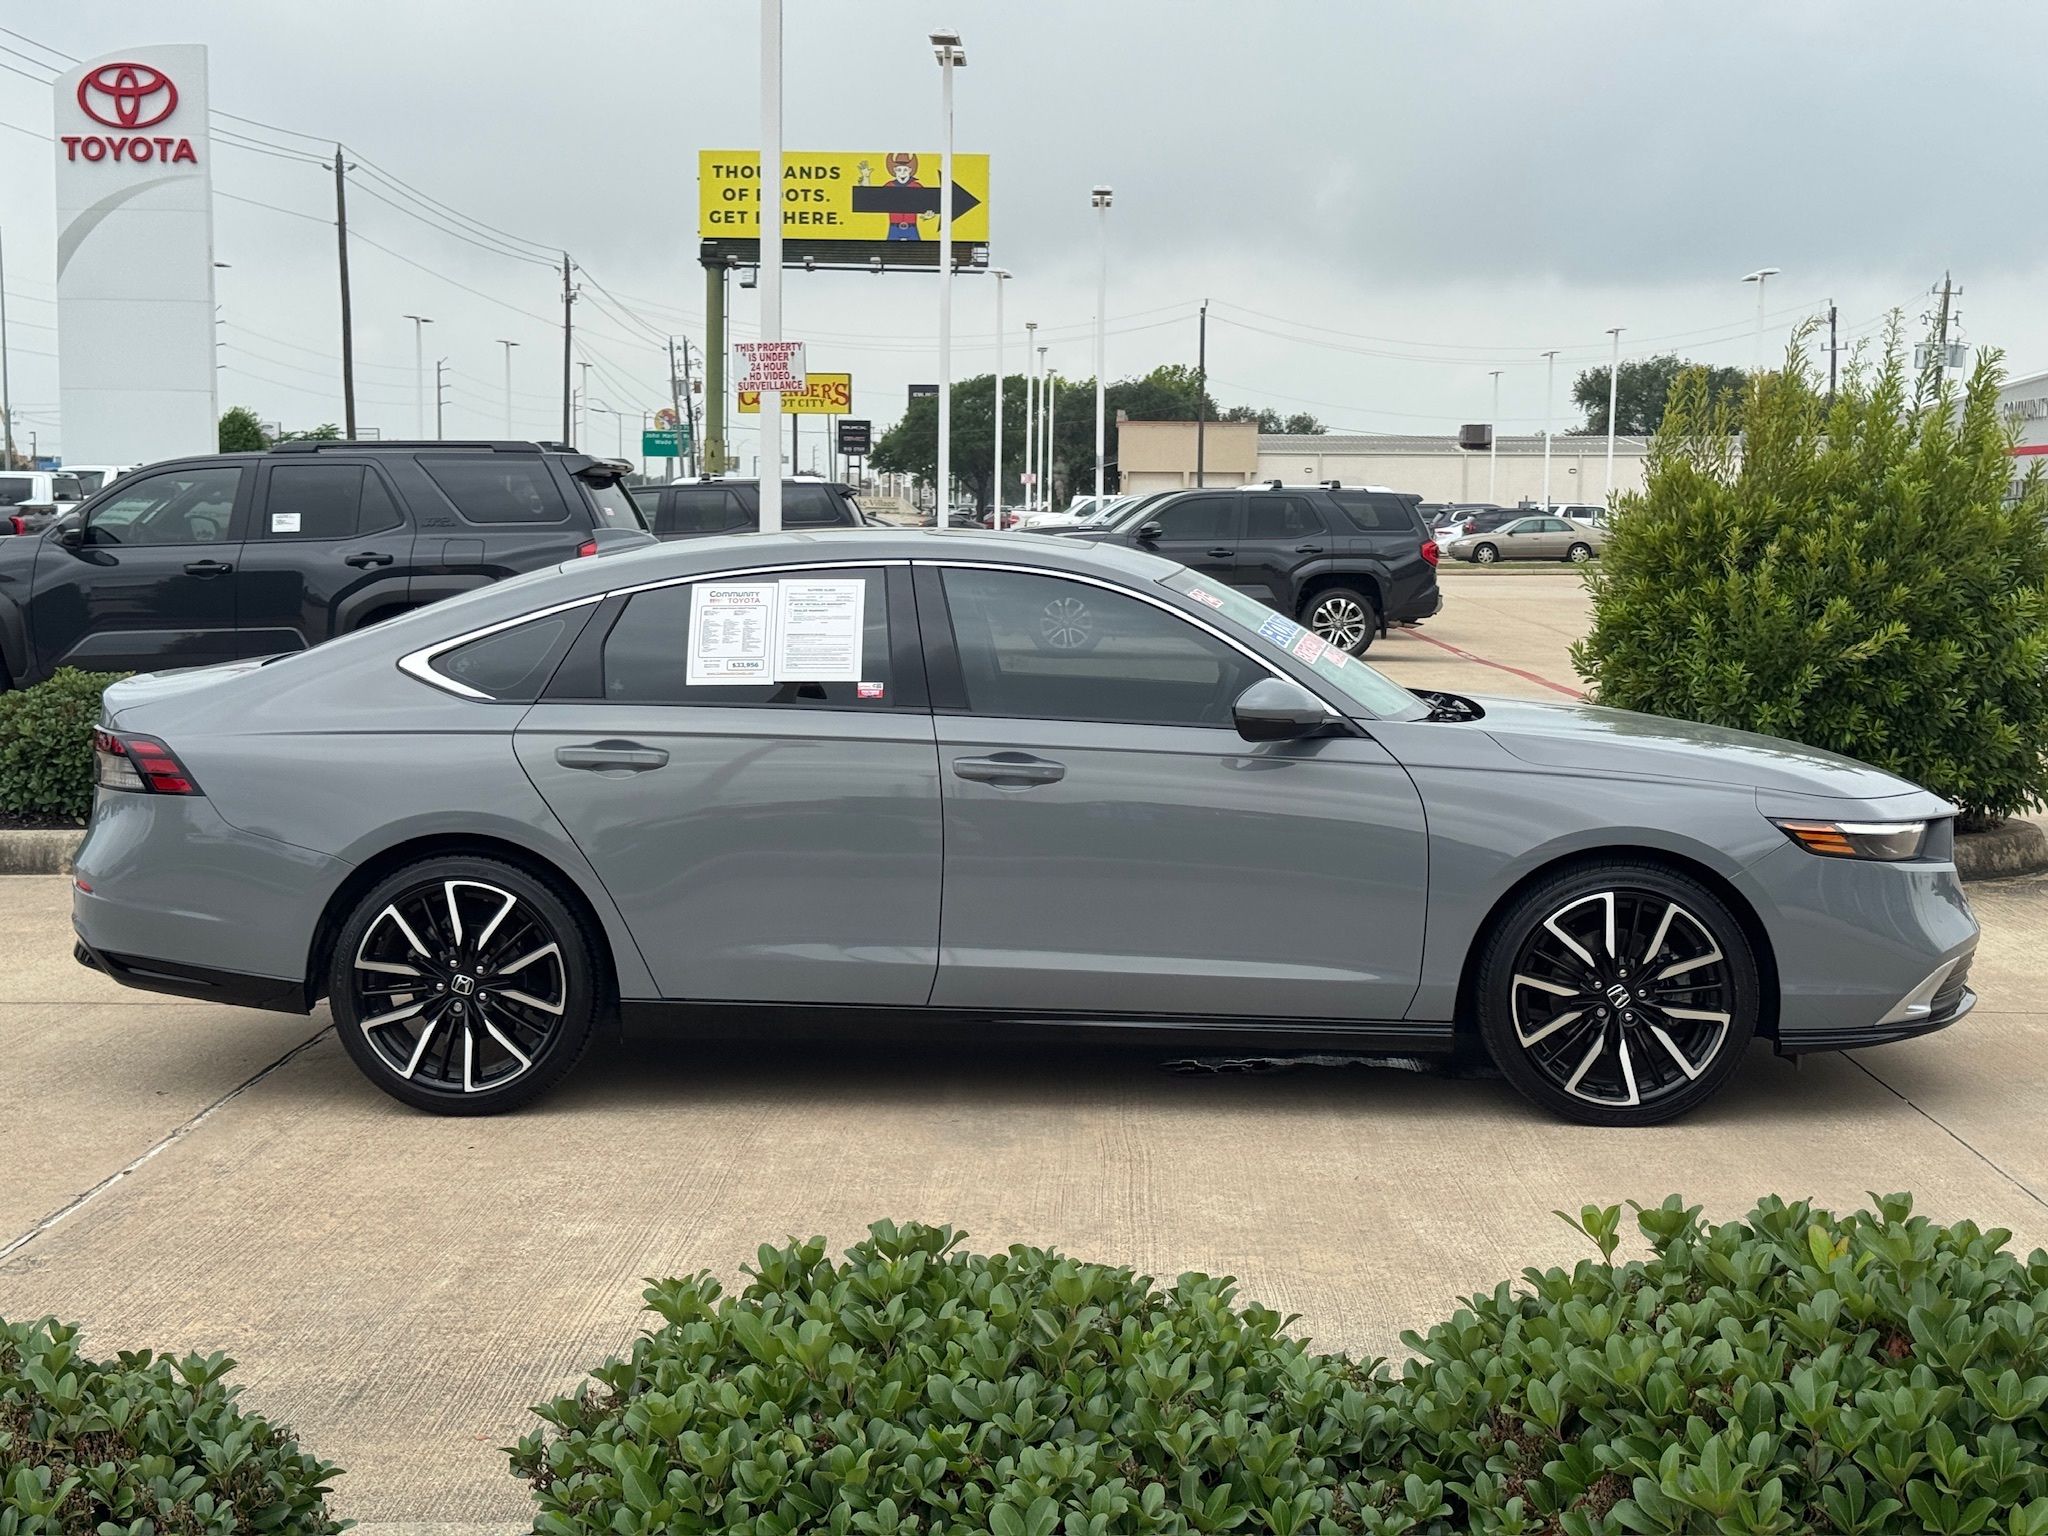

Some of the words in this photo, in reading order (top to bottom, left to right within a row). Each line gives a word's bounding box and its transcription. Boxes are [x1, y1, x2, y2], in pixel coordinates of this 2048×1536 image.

[61, 136, 198, 164] TOYOTA
[712, 165, 841, 180] THOANDS
[722, 188, 749, 201] OF
[709, 210, 748, 224] GET
[783, 211, 844, 225] HERE.
[735, 343, 755, 352] THIS
[757, 342, 803, 352] PROPERTY
[748, 353, 757, 361] IS
[760, 352, 789, 361] UNDER
[751, 363, 761, 371] 24
[763, 362, 788, 371] HOUR
[749, 372, 761, 380] HD
[764, 371, 790, 380] VIDEO
[738, 380, 803, 391] SURVEILLANCE
[798, 399, 825, 407] CITY
